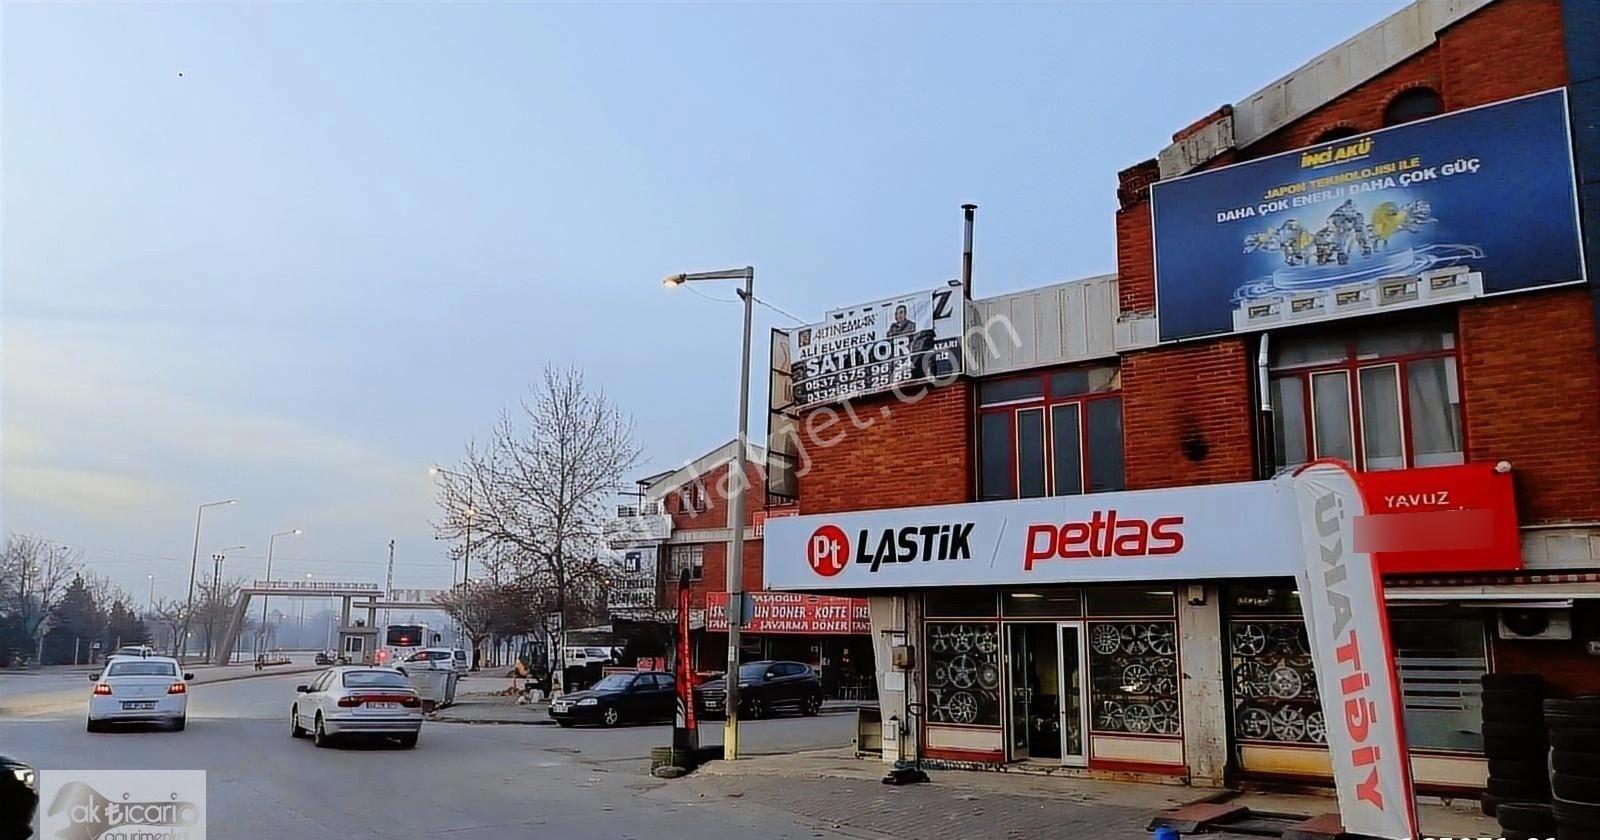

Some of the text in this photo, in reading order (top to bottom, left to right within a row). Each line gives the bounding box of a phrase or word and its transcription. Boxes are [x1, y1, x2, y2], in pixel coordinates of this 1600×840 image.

[1335, 138, 1372, 160] AKÜ
[1217, 207, 1256, 223] DAHA
[1258, 199, 1289, 216] ÇOK
[1349, 176, 1396, 194] DAHA
[1399, 168, 1438, 187] ÇOK
[1441, 158, 1481, 177] GÜÇ
[1264, 183, 1306, 200] JAPON
[821, 331, 876, 353] ELVEREN
[806, 336, 910, 377] SATIYOR
[839, 368, 866, 383] 675
[871, 376, 889, 388] 25
[1385, 491, 1450, 508] YAVUZ
[1024, 509, 1185, 571] petlas
